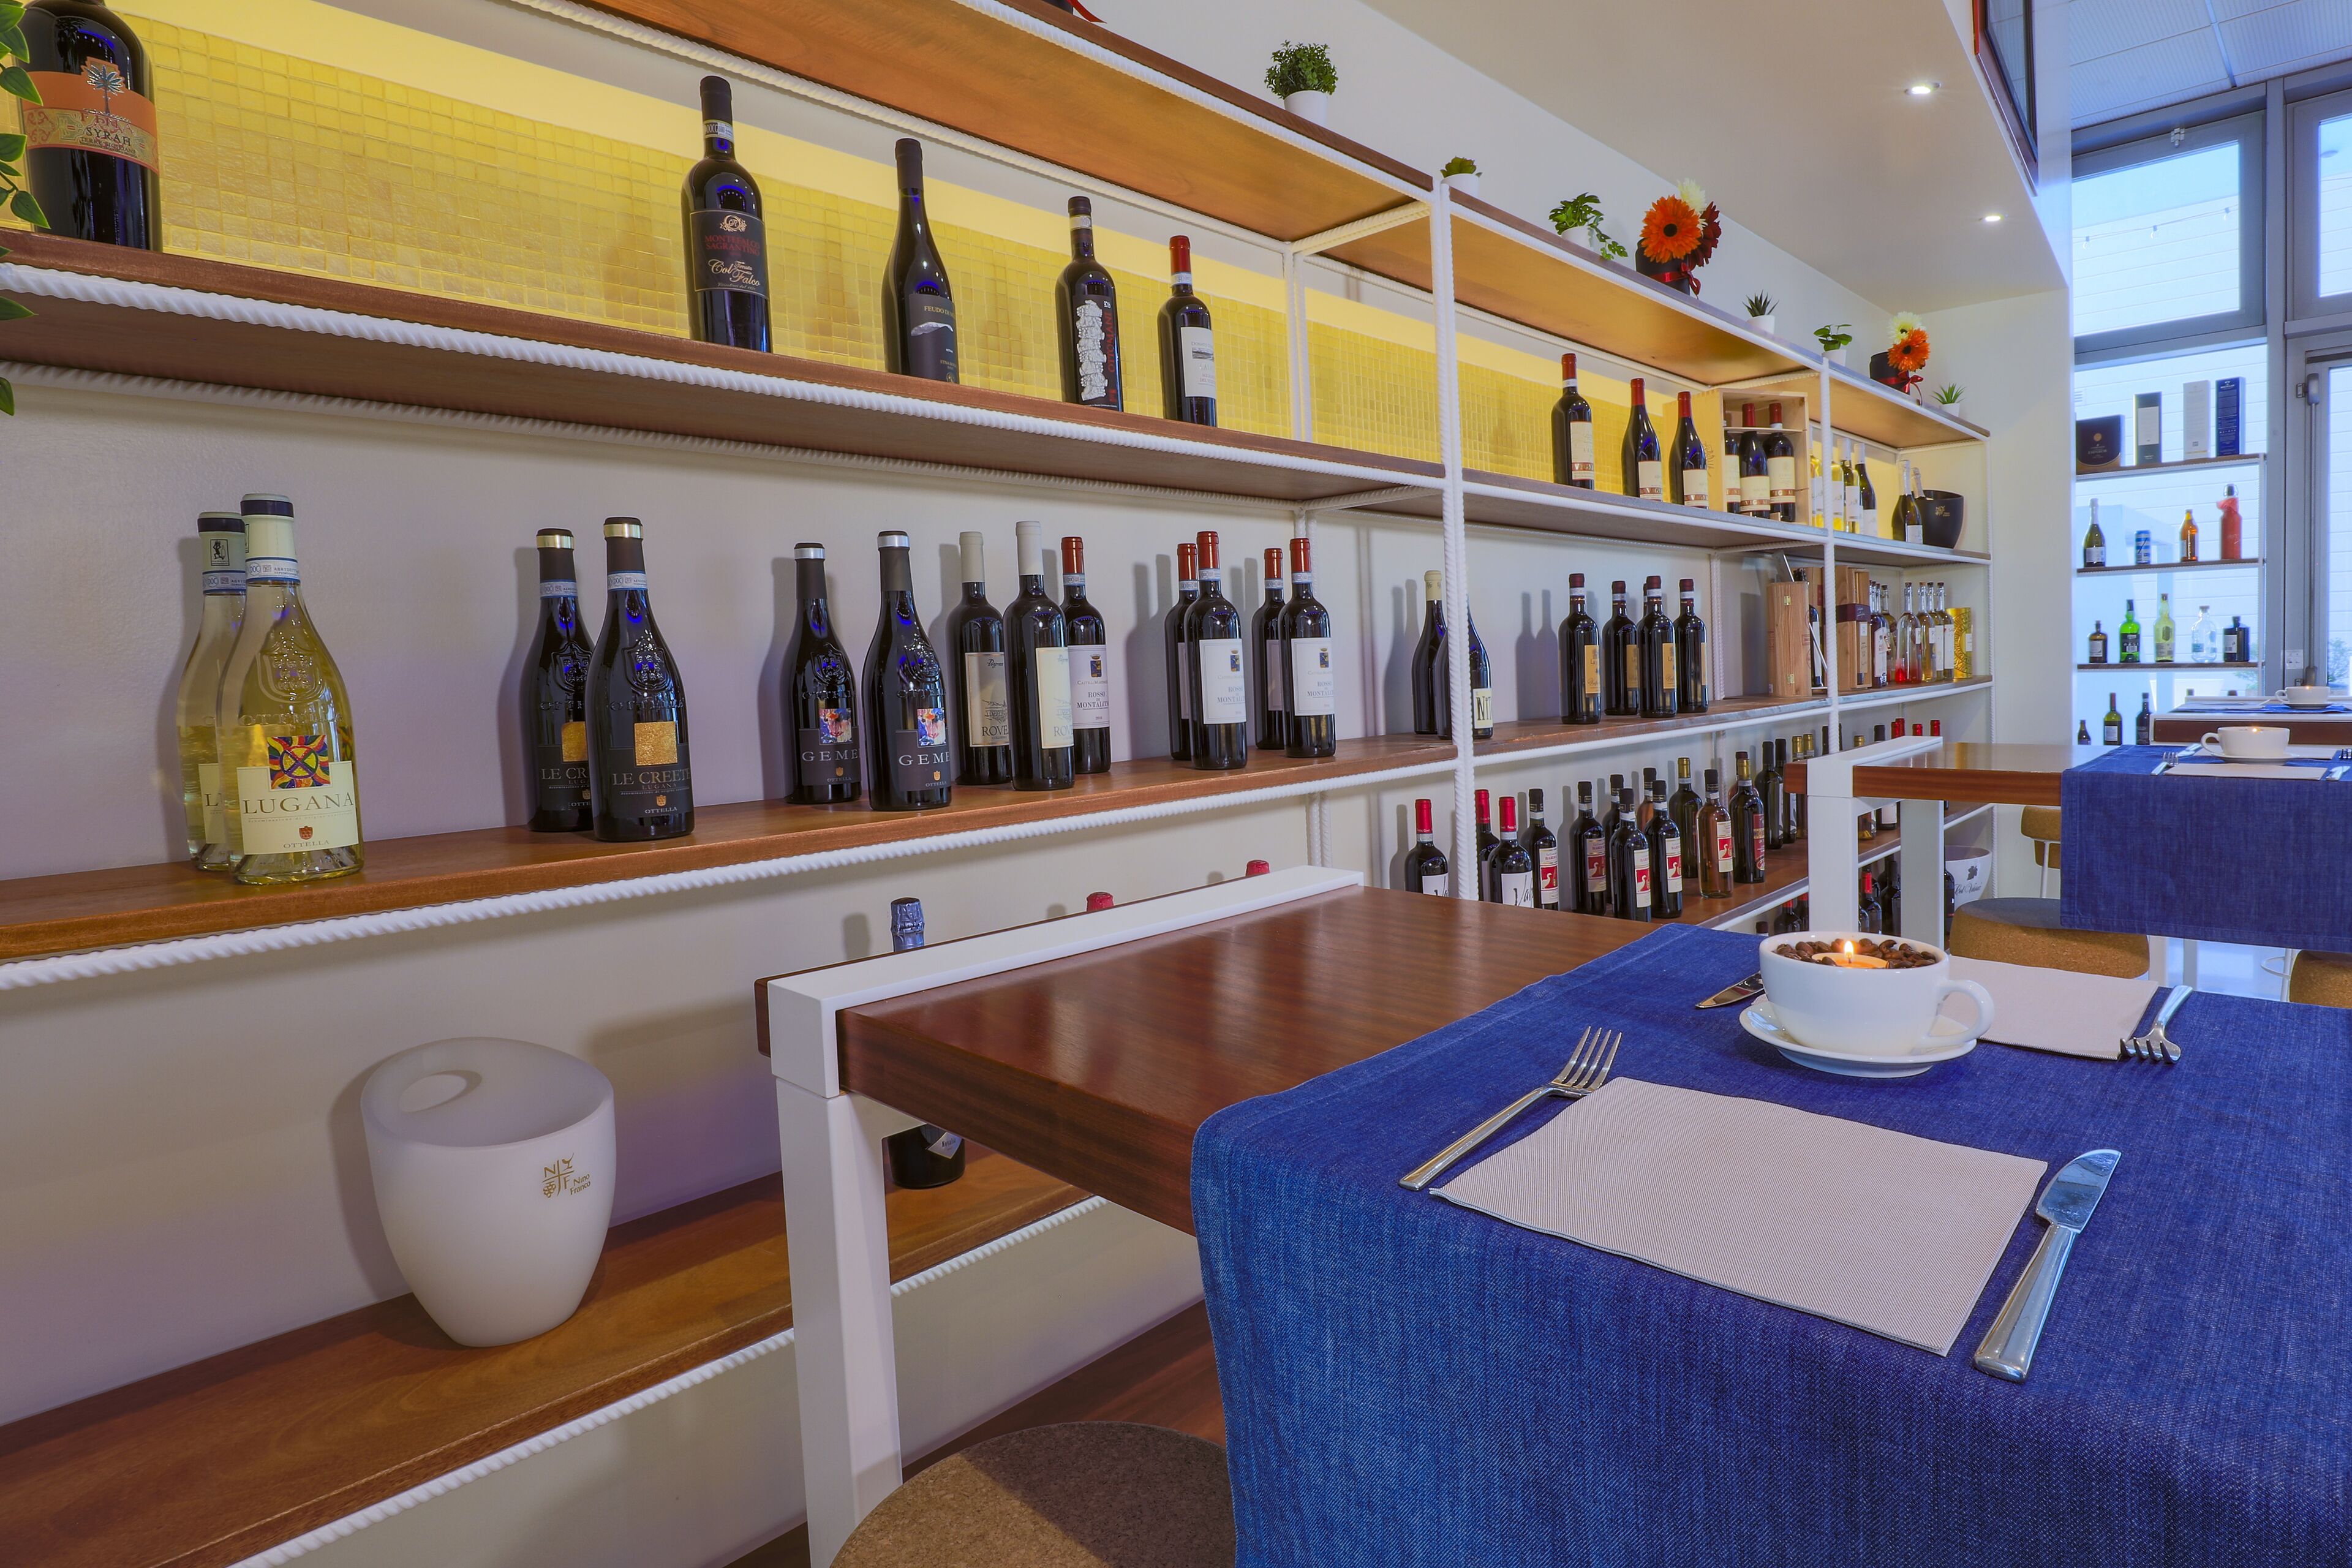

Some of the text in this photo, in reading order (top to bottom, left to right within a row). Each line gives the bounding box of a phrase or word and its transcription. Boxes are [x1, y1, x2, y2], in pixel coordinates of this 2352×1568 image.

[86, 127, 130, 146] SYRAH
[706, 243, 760, 256] SAGRANTINO
[708, 258, 761, 287] Col Falco
[924, 306, 944, 314] FEUDO
[1104, 312, 1116, 373] OTTOMANI
[541, 768, 562, 780] LE
[612, 767, 691, 785] LE CREETE
[243, 792, 355, 815] LUGANA
[644, 806, 678, 815] OTTELLA
[283, 839, 330, 849] OTTELLA
[573, 1174, 590, 1186] Nino
[570, 1181, 591, 1196] Franco
